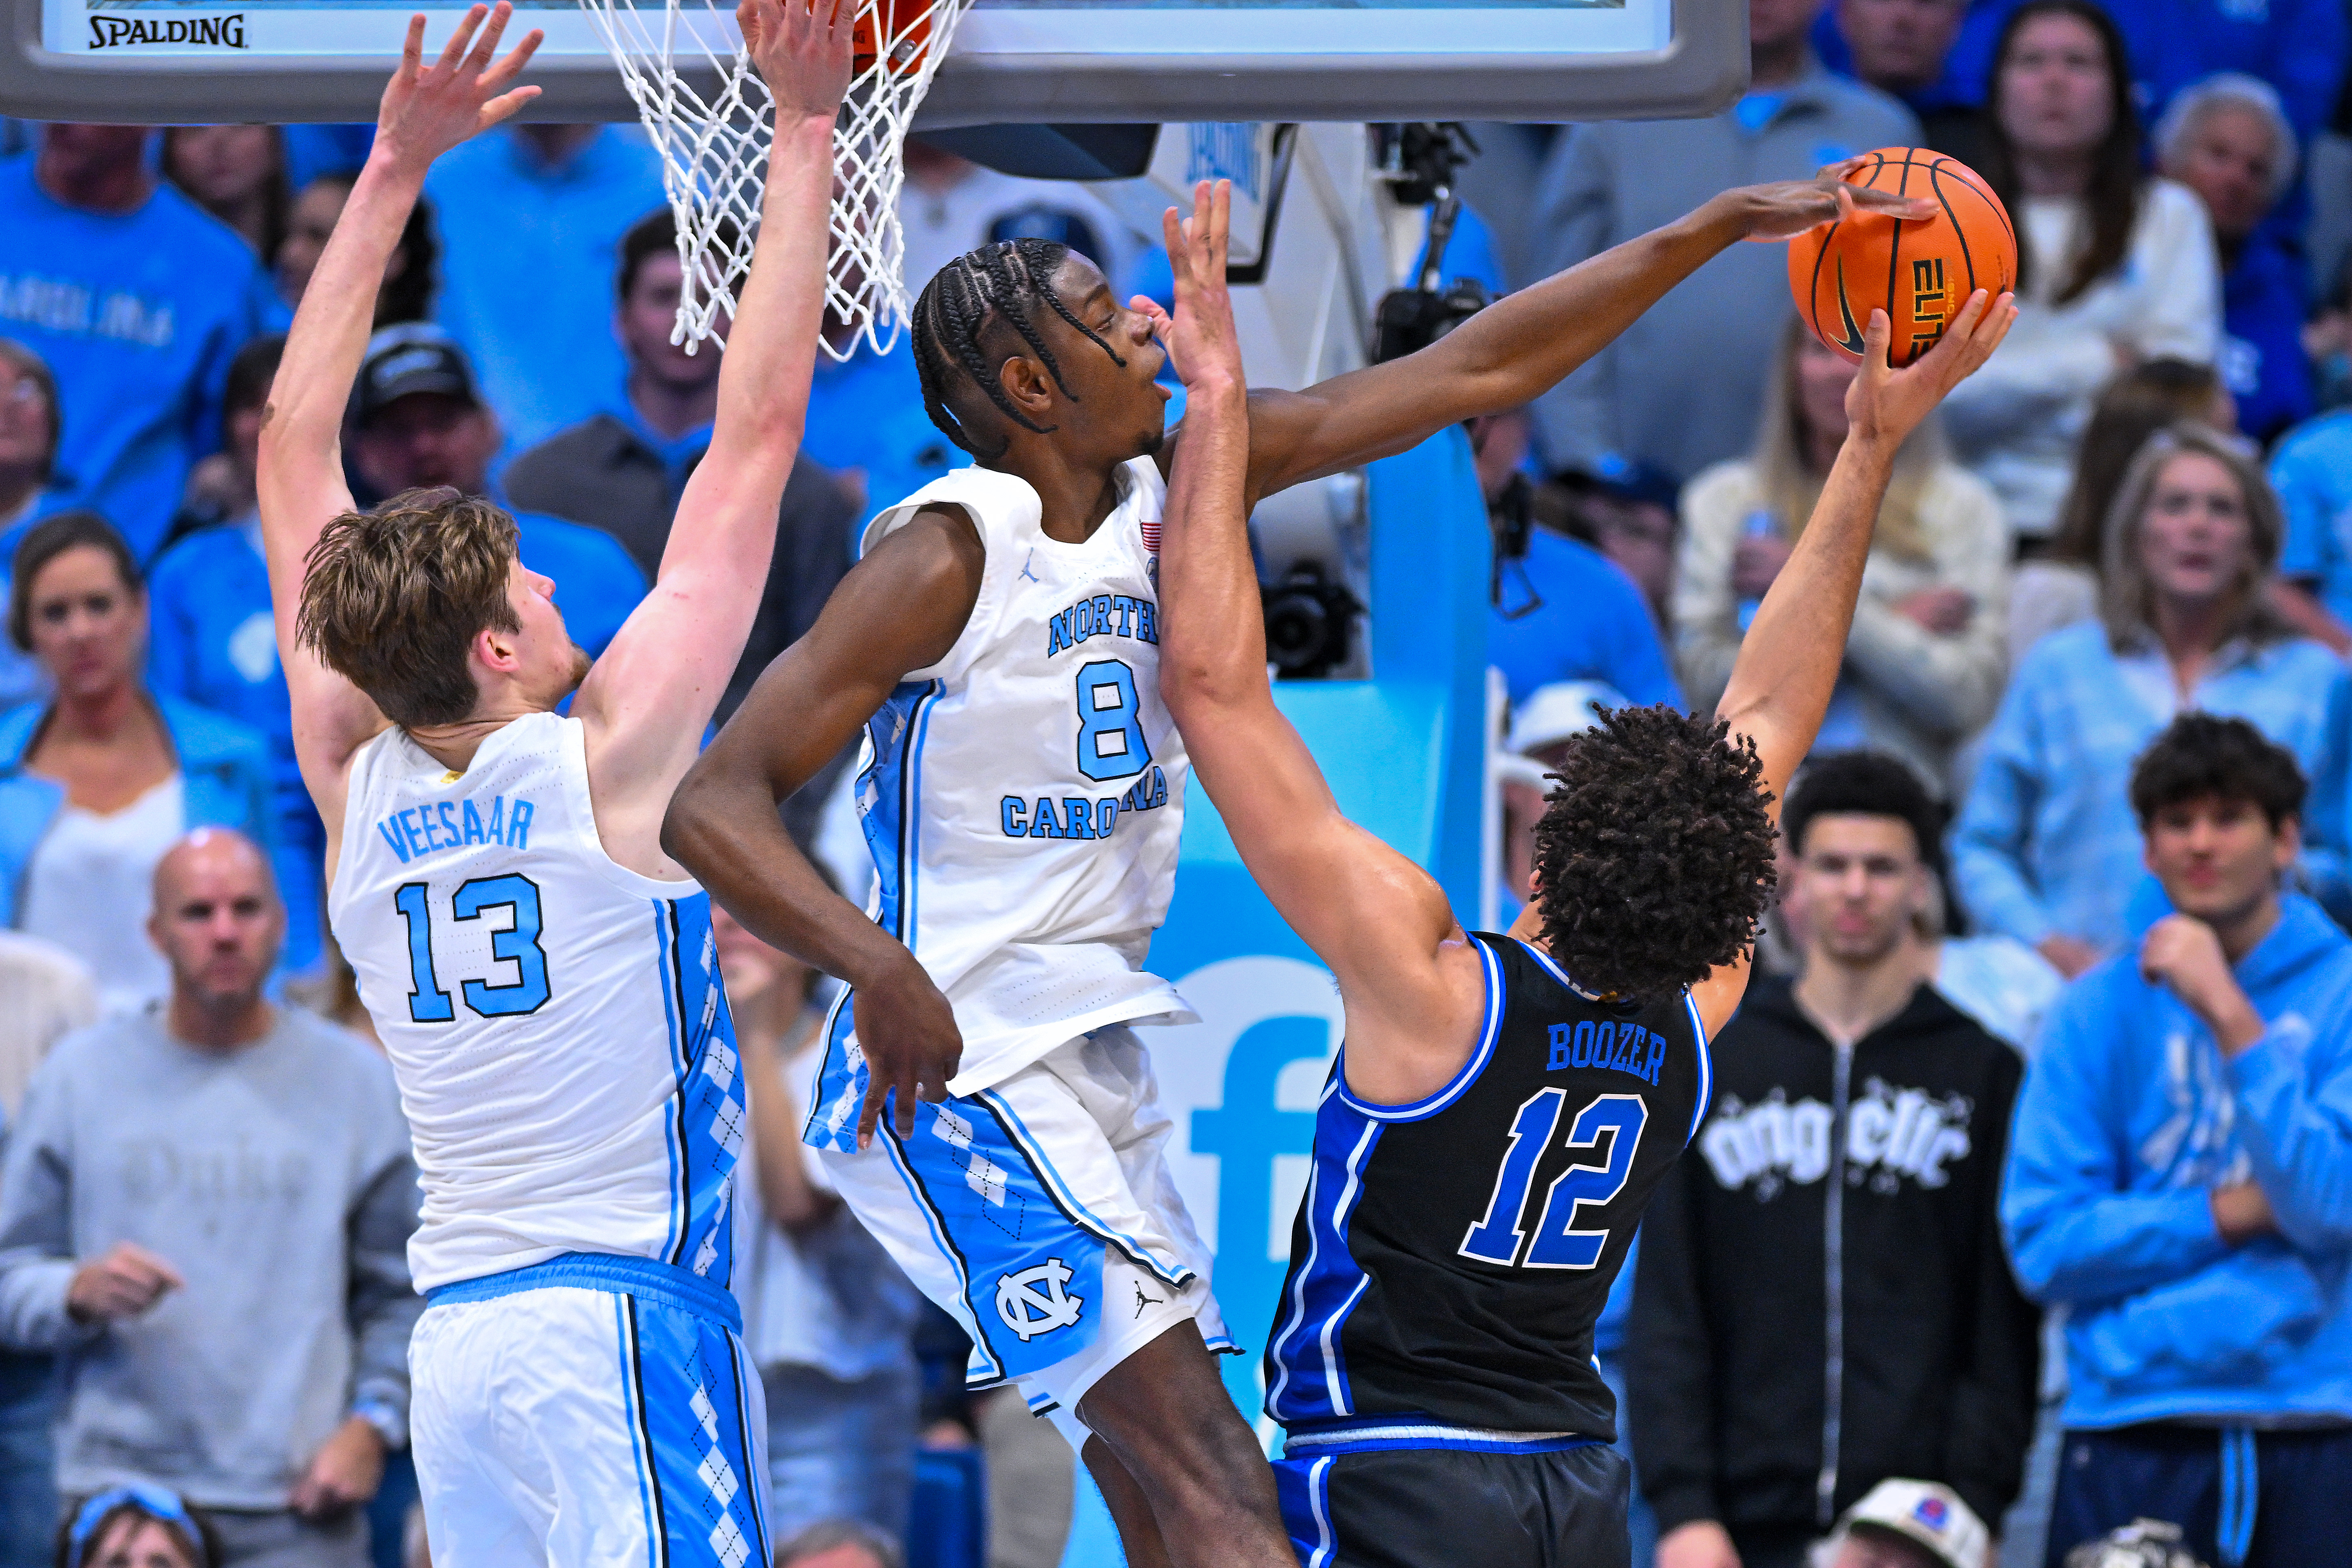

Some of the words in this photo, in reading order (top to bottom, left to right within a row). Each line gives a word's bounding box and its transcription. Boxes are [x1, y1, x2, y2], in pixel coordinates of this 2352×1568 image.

[89, 14, 245, 49] SPALDING
[1048, 594, 1159, 659] NORTH
[1076, 658, 1153, 782] 8
[378, 796, 535, 864] VEESAAR
[1000, 765, 1169, 840] CARONA
[394, 872, 552, 1023] 13
[1546, 1021, 1667, 1086] BOOZER
[1457, 1086, 1648, 1270] 12
